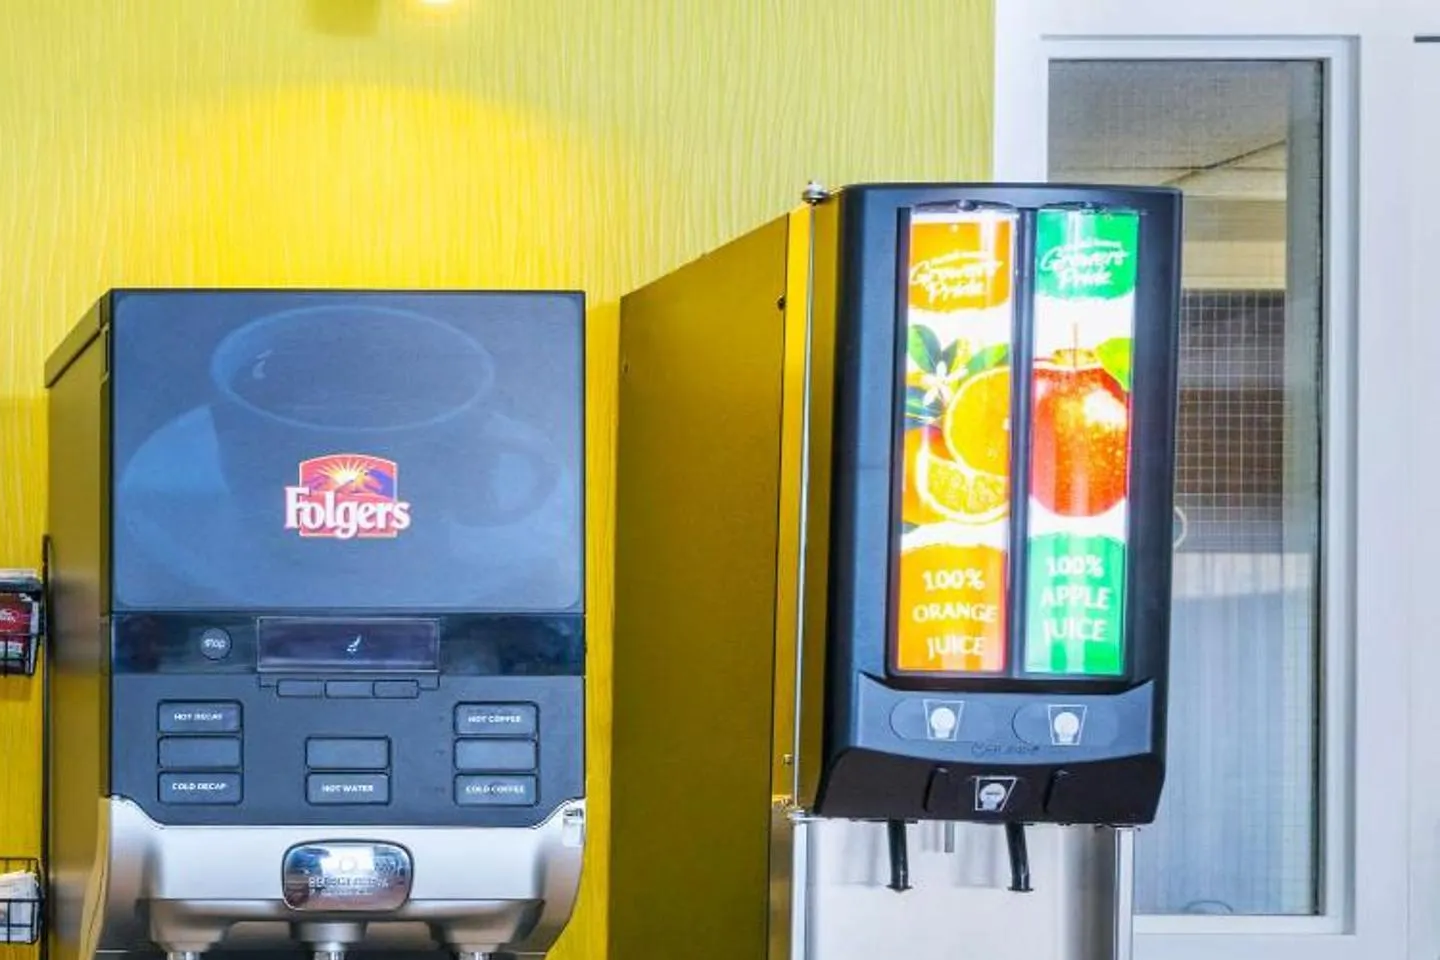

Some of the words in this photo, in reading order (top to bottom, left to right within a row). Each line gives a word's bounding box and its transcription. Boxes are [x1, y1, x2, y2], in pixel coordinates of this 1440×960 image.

[284, 486, 411, 539] Folgers
[1047, 555, 1104, 578] 100%
[922, 568, 985, 591] 100%
[1041, 586, 1111, 610] APPLE
[912, 602, 999, 624] ORANGE
[1043, 619, 1107, 646] JUICE
[926, 635, 987, 660] JUICE
[173, 712, 193, 721] HOT
[467, 715, 487, 723] HOT
[171, 782, 196, 791] COLD
[321, 784, 342, 792] HOT
[343, 784, 374, 793] WATER
[465, 784, 490, 794] COLD
